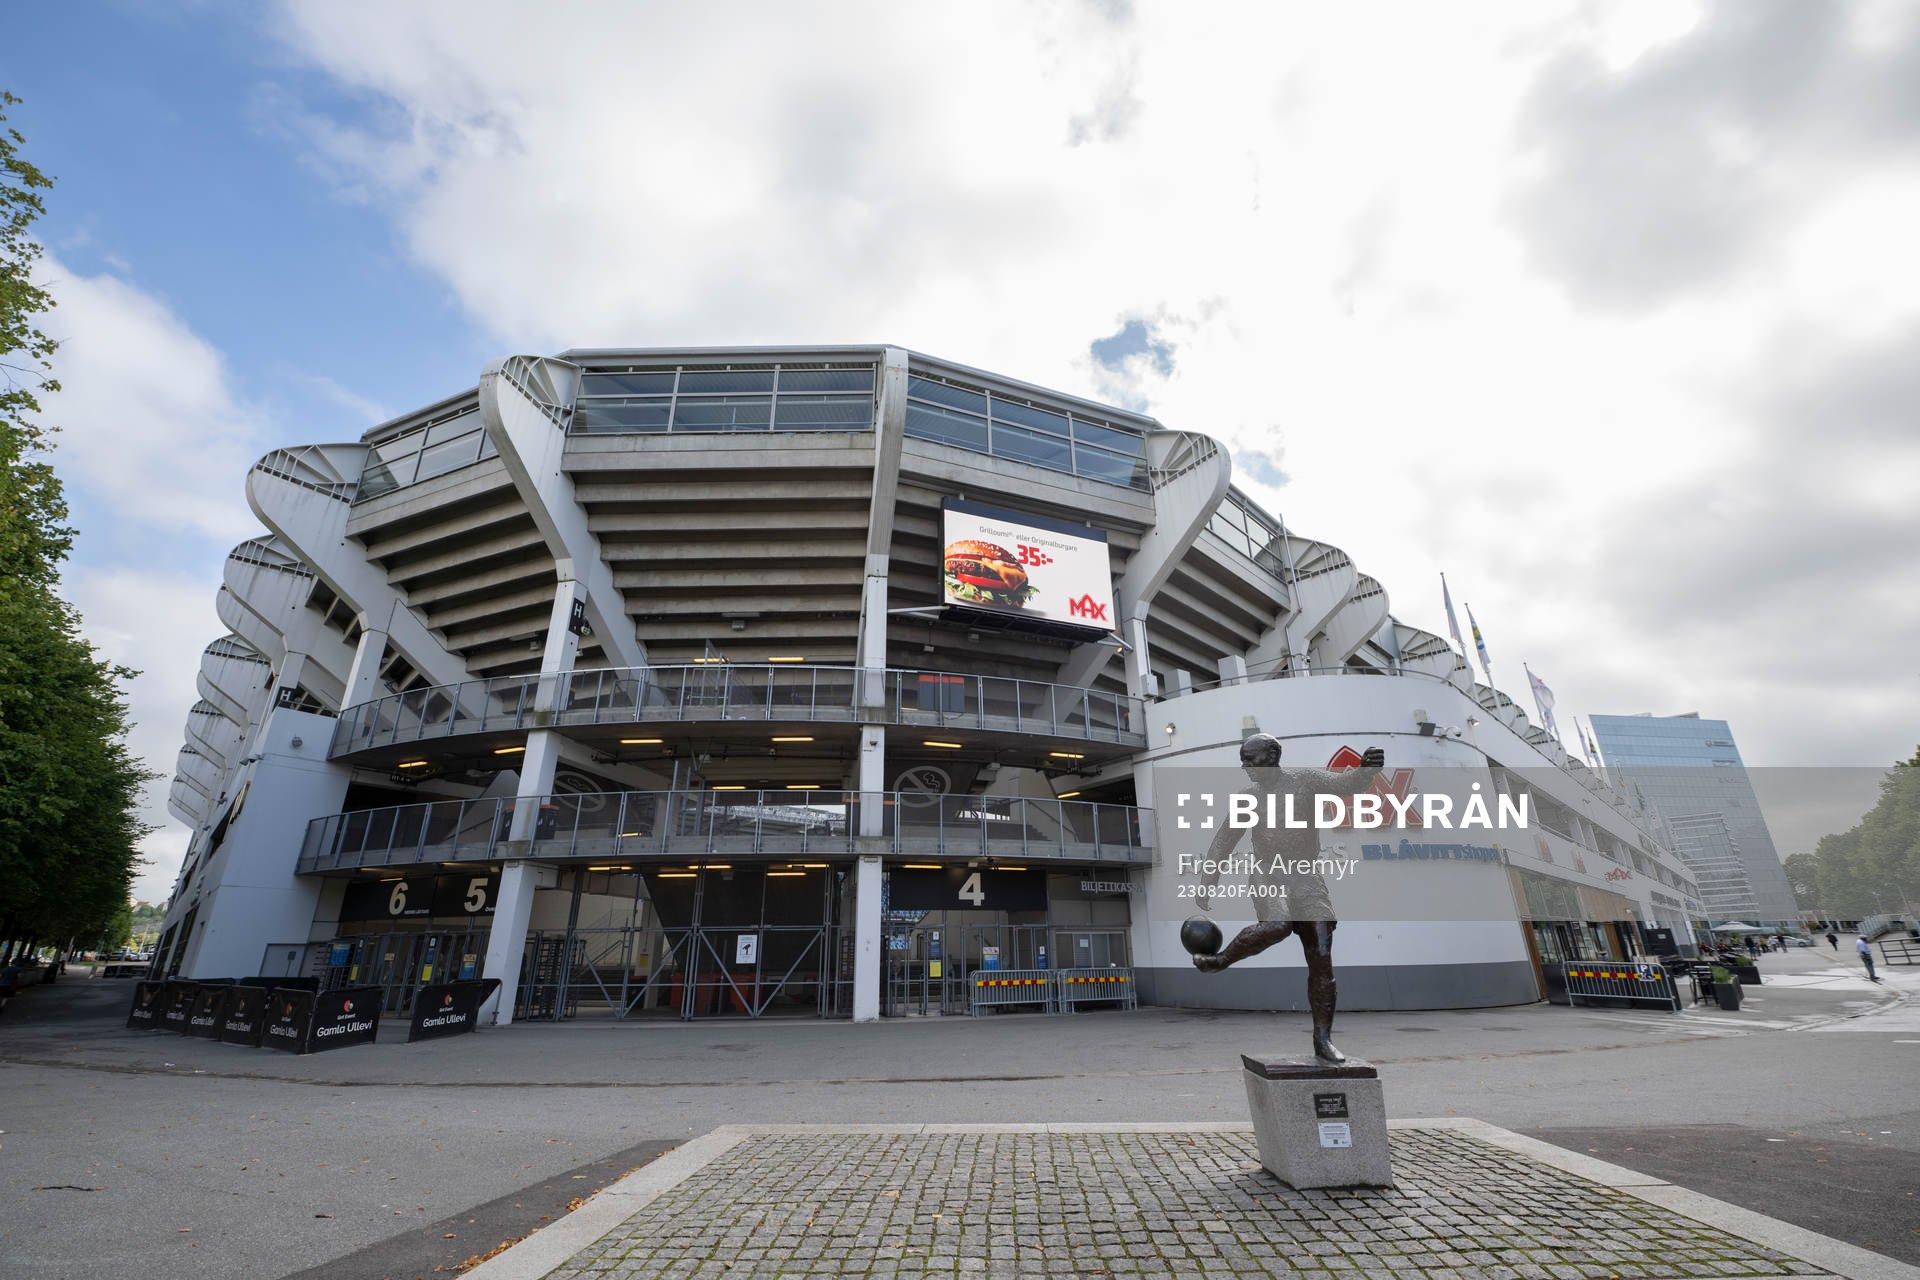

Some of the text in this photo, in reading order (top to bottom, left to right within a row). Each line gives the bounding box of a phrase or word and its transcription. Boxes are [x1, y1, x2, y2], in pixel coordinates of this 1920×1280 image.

[1016, 533, 1030, 542] eller
[1031, 536, 1078, 552] Originalburgare
[1016, 544, 1054, 567] 35:-
[573, 603, 583, 618] H
[1068, 593, 1109, 622] MAX
[280, 690, 291, 701] H
[388, 882, 409, 915] 6
[463, 877, 489, 913] 5
[958, 872, 985, 906] 4
[317, 1019, 373, 1037] Gamla Ullevi
[422, 1013, 466, 1028] Gamla Ullevi
[270, 1024, 298, 1038] Gamla Ullevi
